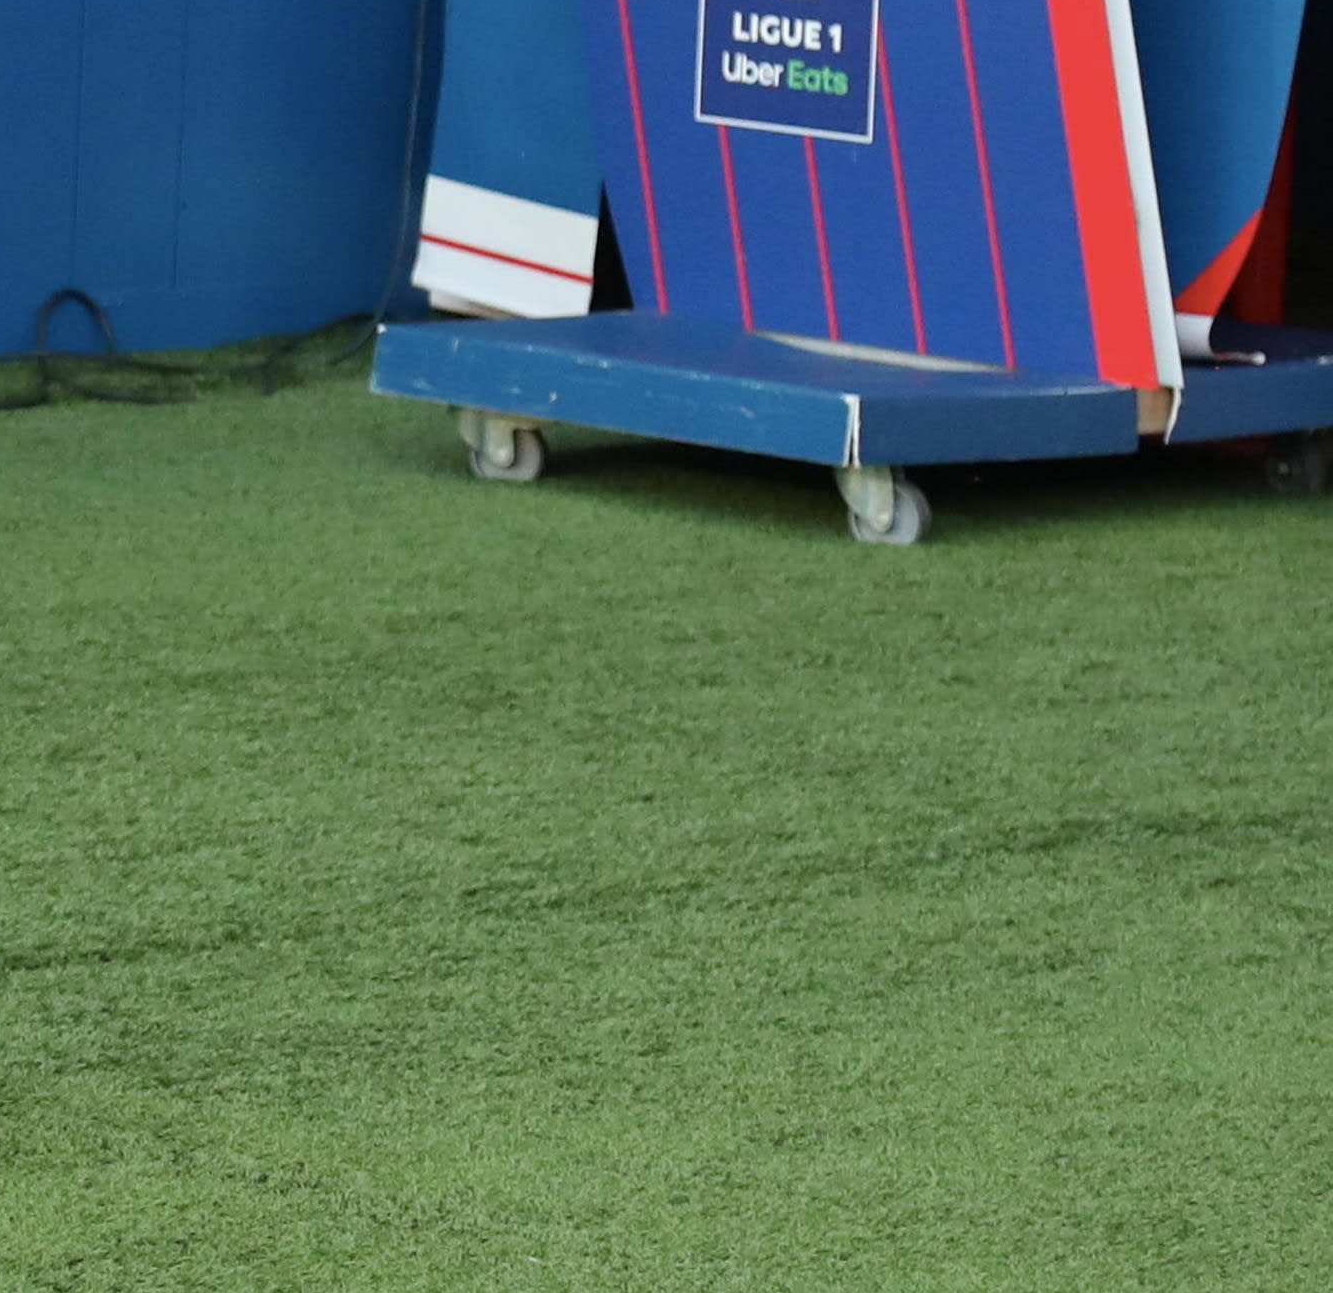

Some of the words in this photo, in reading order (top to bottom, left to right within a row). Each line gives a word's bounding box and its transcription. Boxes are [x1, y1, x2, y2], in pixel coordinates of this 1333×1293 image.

[733, 11, 822, 51] LIGUE
[828, 22, 843, 54] 1
[722, 49, 784, 88] Uber
[787, 59, 849, 96] Eats
